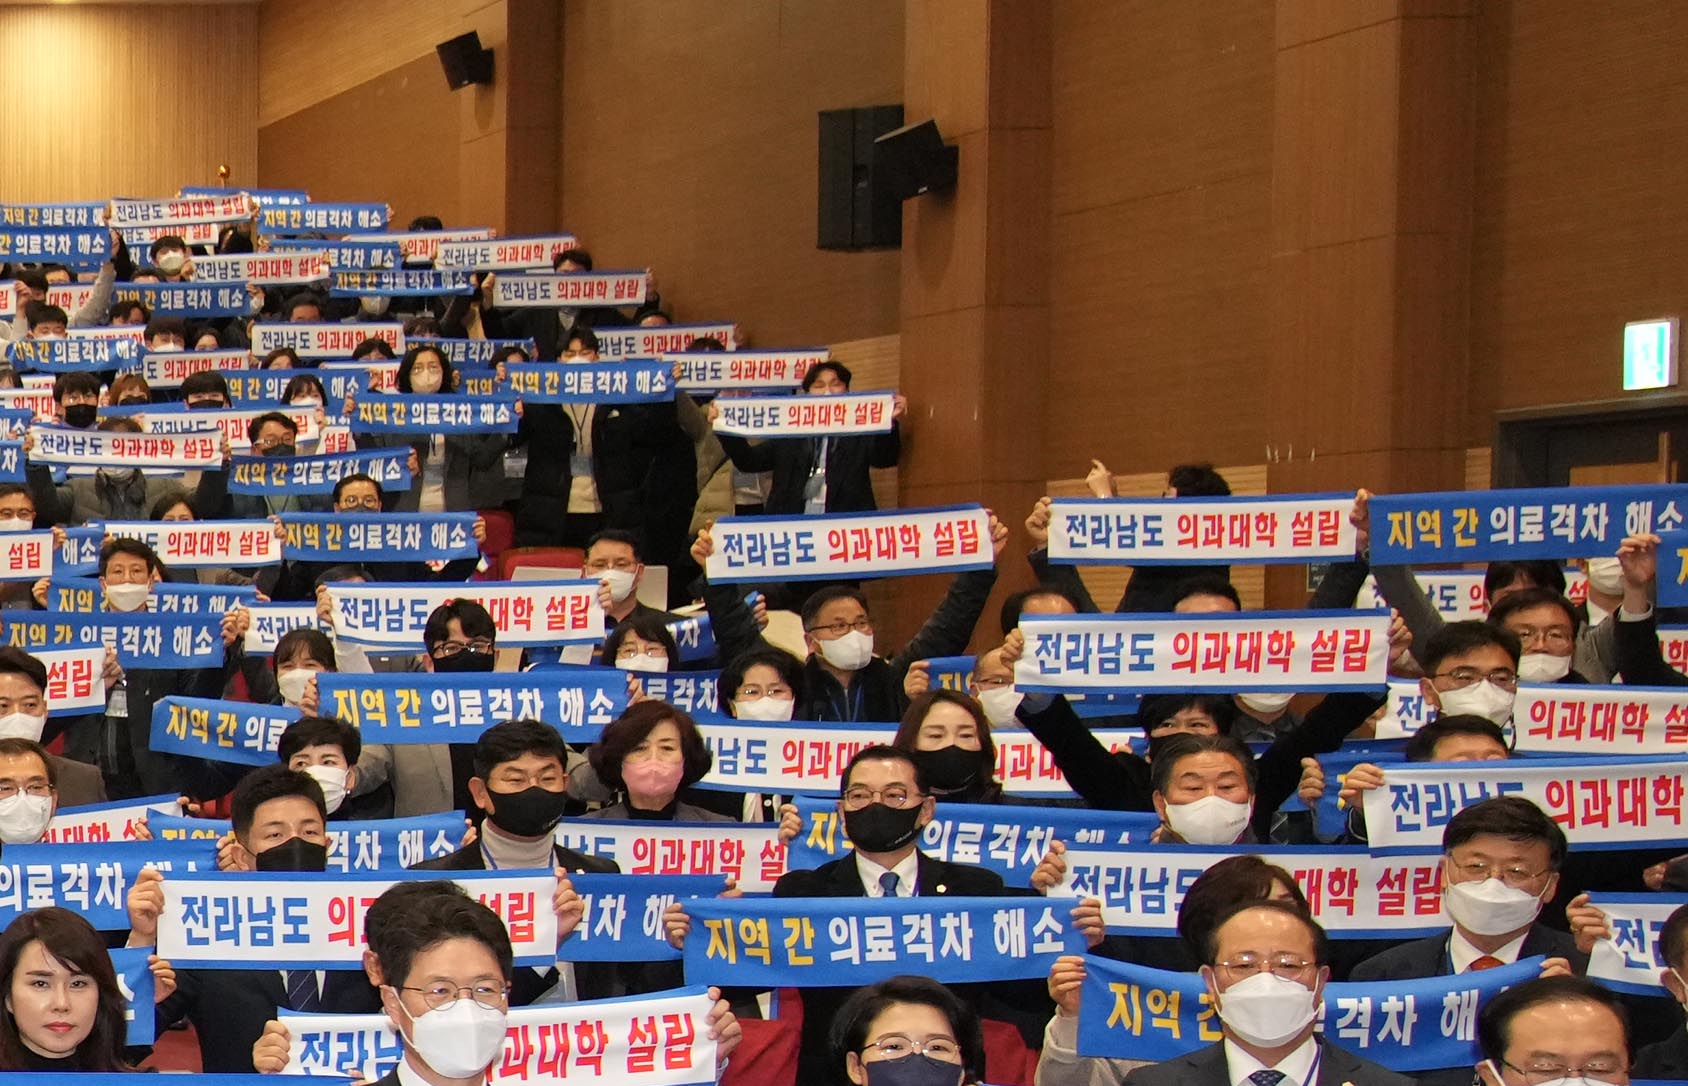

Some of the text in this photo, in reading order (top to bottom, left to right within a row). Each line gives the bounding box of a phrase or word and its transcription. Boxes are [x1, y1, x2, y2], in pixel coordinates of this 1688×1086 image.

[264, 211, 380, 228] 지역 간 의료격차 해소
[724, 402, 883, 427] 전라남도 의과대학 설립
[40, 435, 213, 459] 전라남도 의과대학 설립
[286, 521, 465, 549] 지역 간 의료격차 해소
[724, 519, 978, 566] 전라남도 의과대학 설립
[1066, 510, 1340, 548] 전라남도 의과대학 설립
[1035, 628, 1371, 674] 전라남도 의과대학 설립
[48, 658, 93, 698] 설립
[333, 685, 613, 726] 지역 간 의료격차 해소
[1545, 775, 1686, 829] 의과대학
[1377, 865, 1441, 914] 설립
[706, 907, 1063, 965] 지역 간 의료격차 해소
[1109, 983, 1182, 1037] 지역
[629, 1013, 696, 1071] 설립
